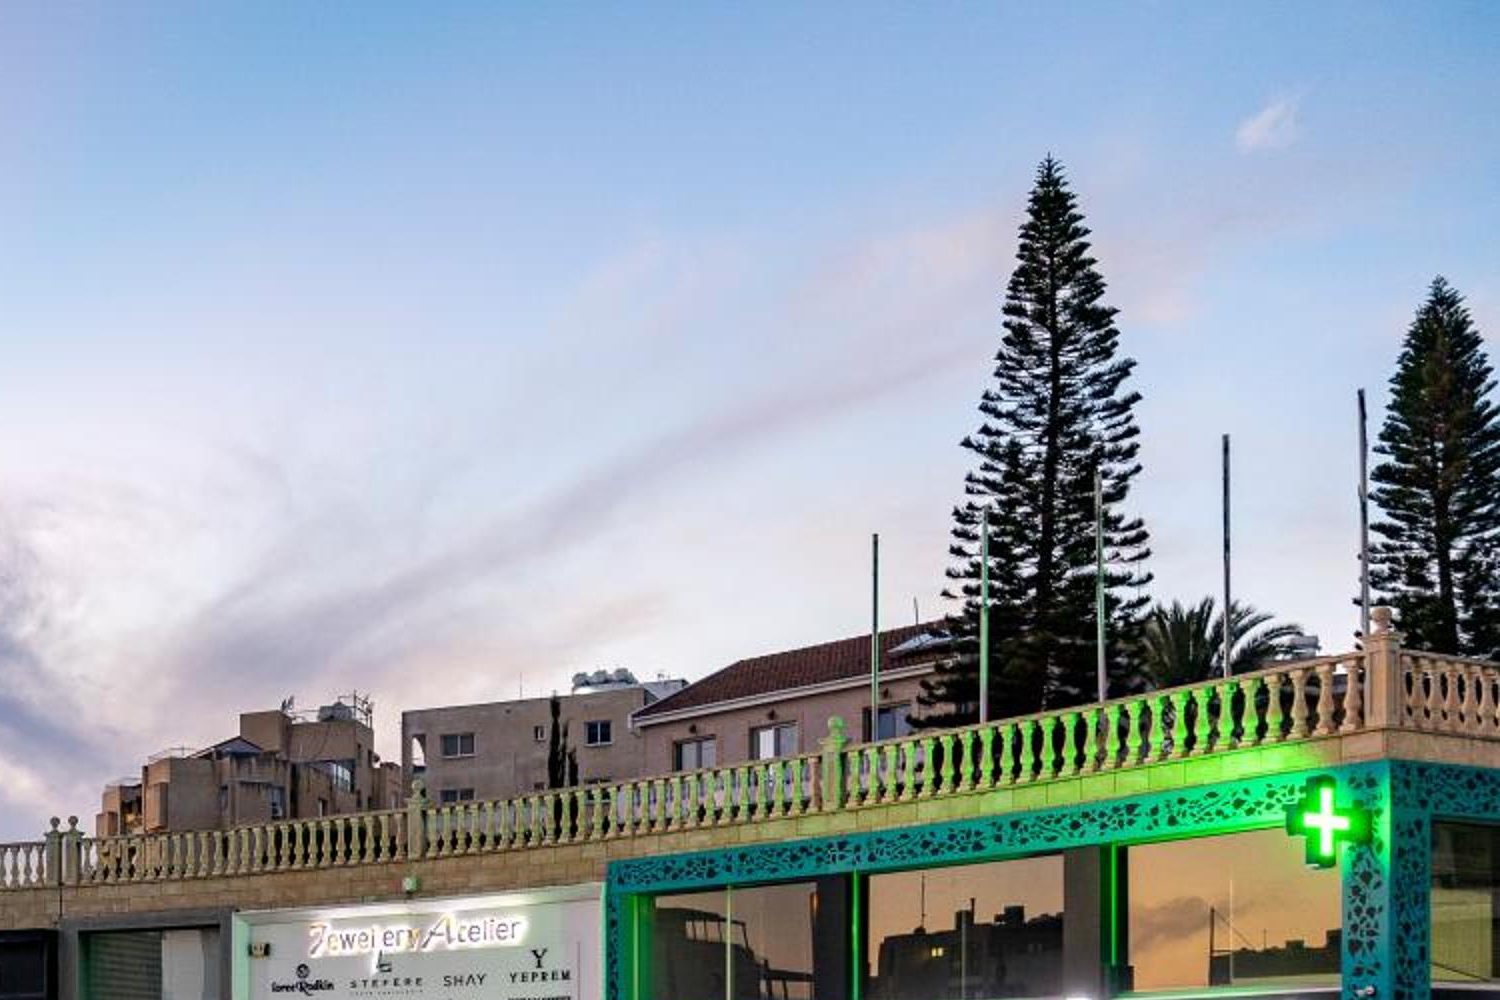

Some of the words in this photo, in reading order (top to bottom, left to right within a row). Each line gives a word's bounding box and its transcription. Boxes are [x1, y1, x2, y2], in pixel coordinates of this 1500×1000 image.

[420, 912, 522, 949] Atelier
[443, 973, 487, 987] SHAY
[509, 970, 571, 984] YEPREM
